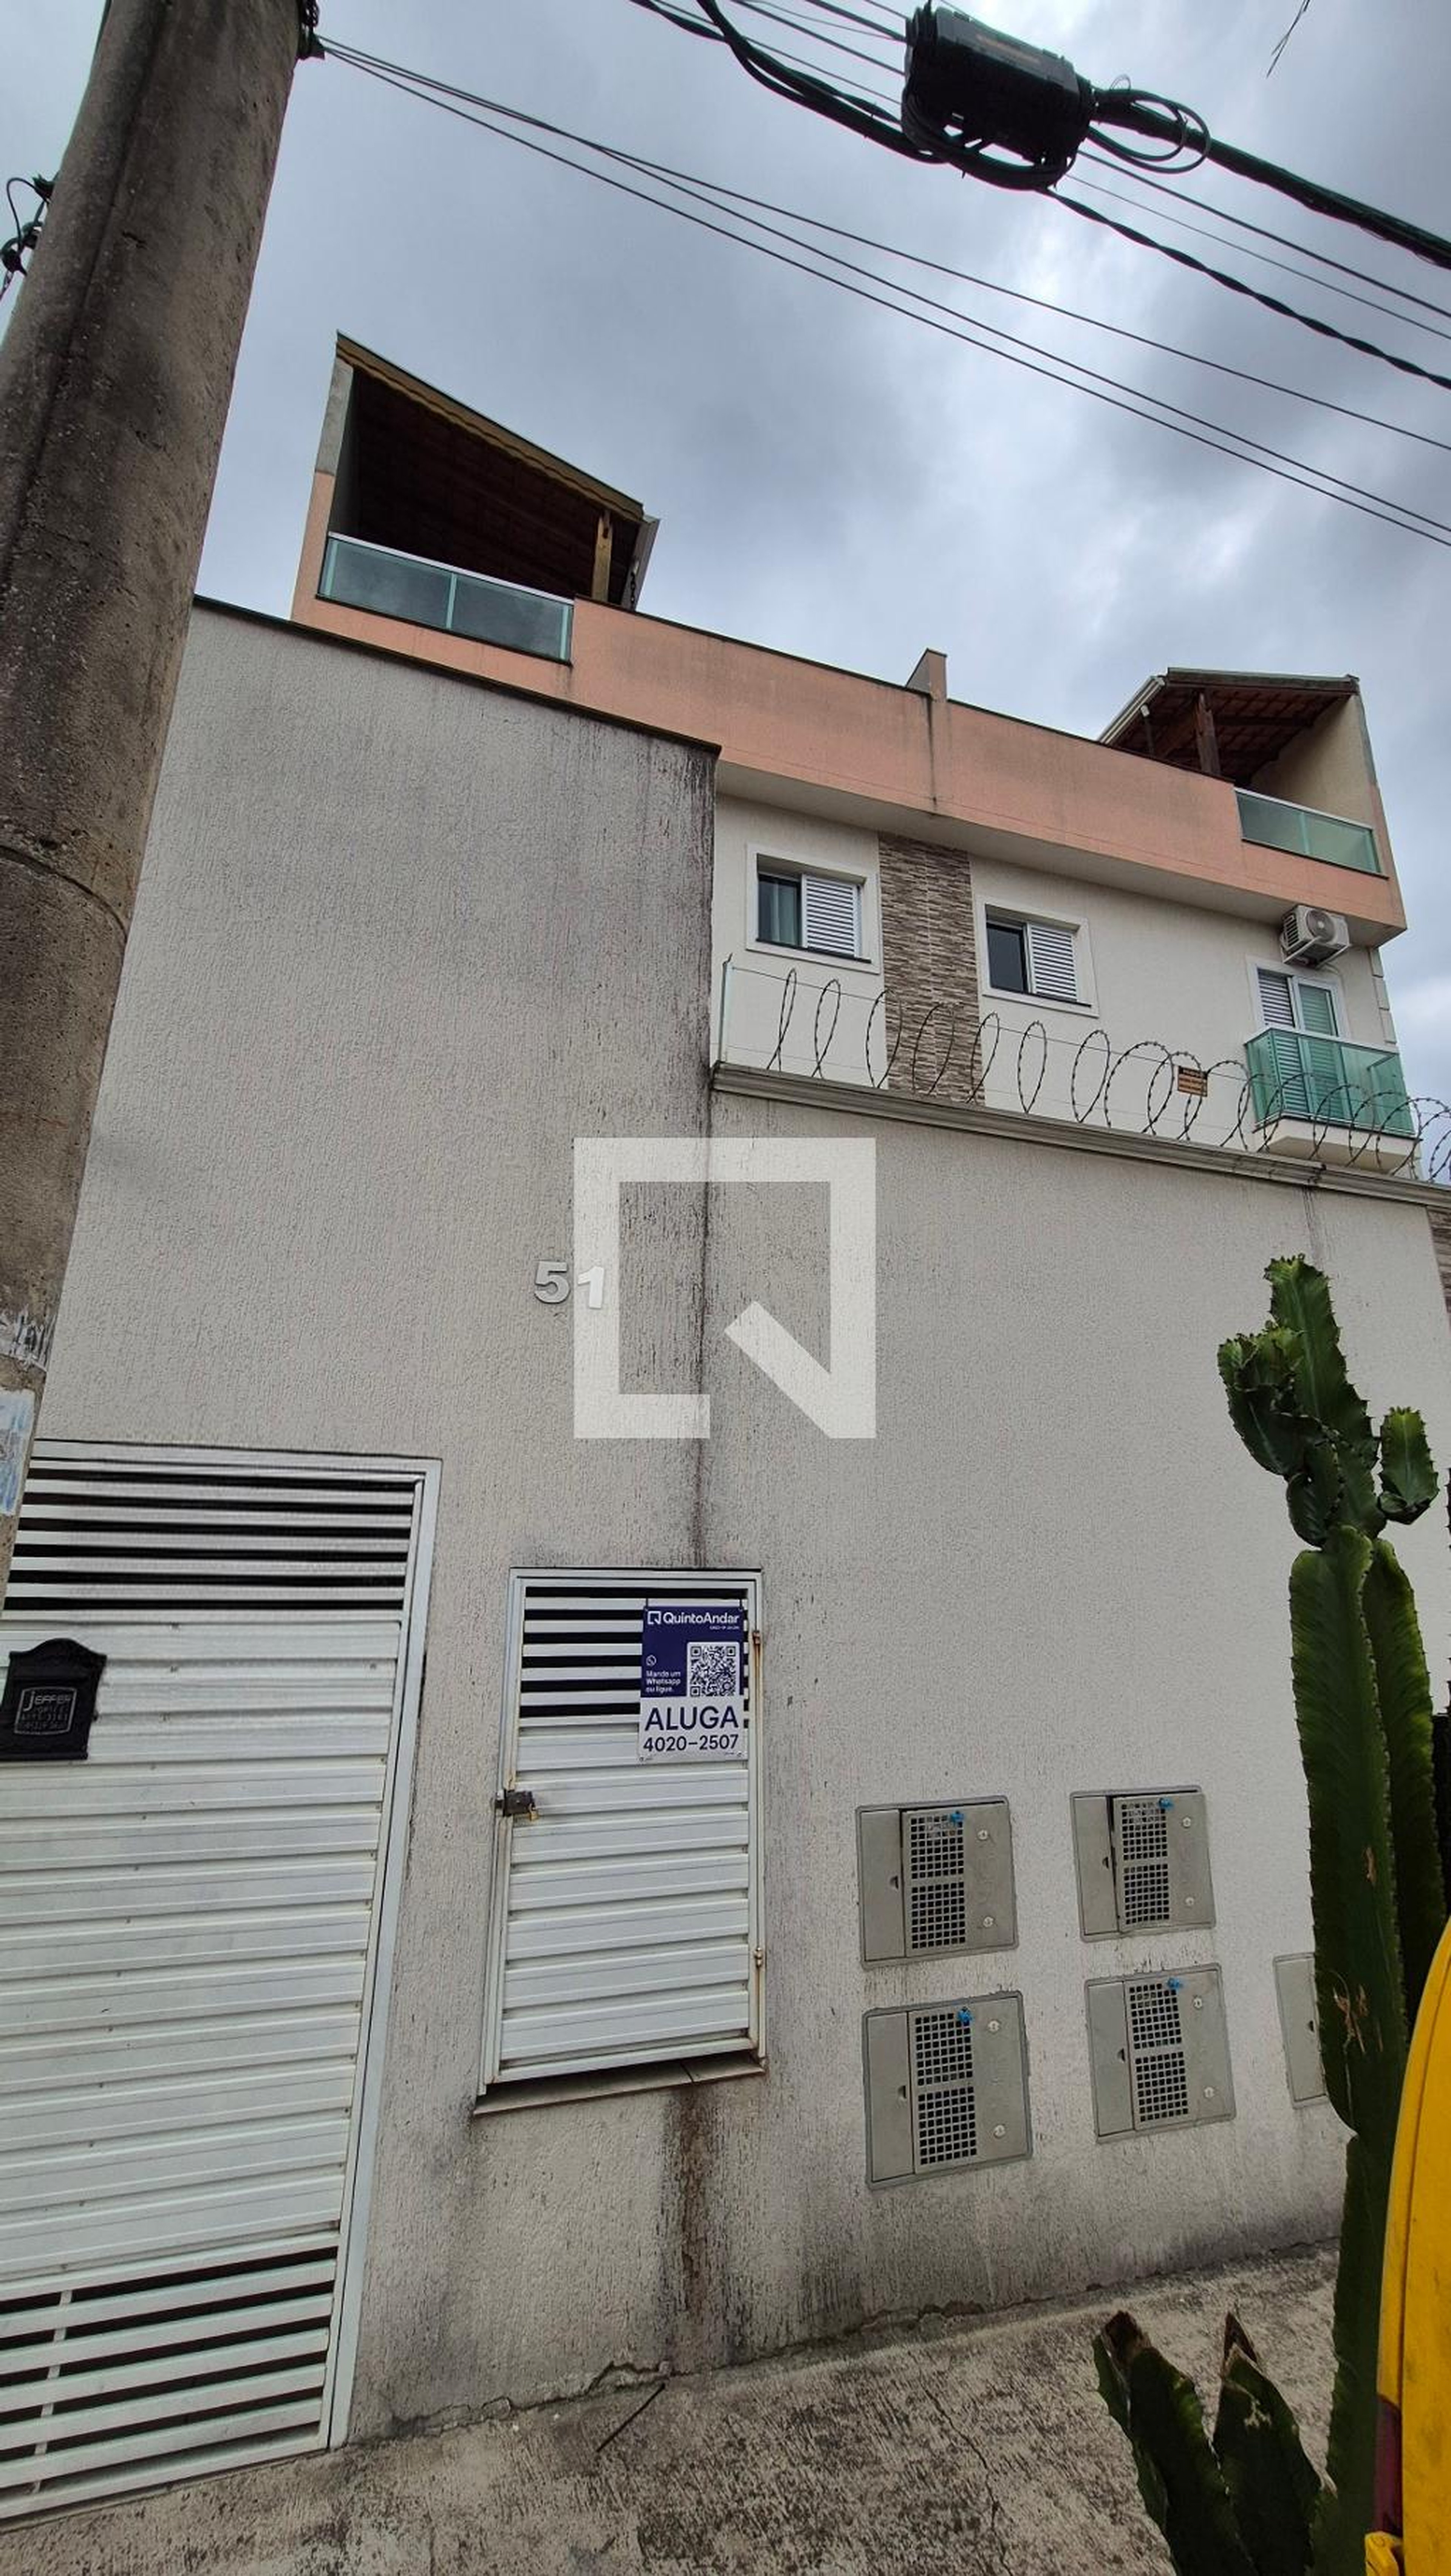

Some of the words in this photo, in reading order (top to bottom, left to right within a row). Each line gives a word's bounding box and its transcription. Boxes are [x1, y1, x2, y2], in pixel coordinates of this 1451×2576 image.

[534, 1261, 604, 1308] 51
[663, 1612, 739, 1624] QuintoAndar
[645, 1706, 739, 1731] ALUGA
[644, 1735, 739, 1752] 4020-2507
